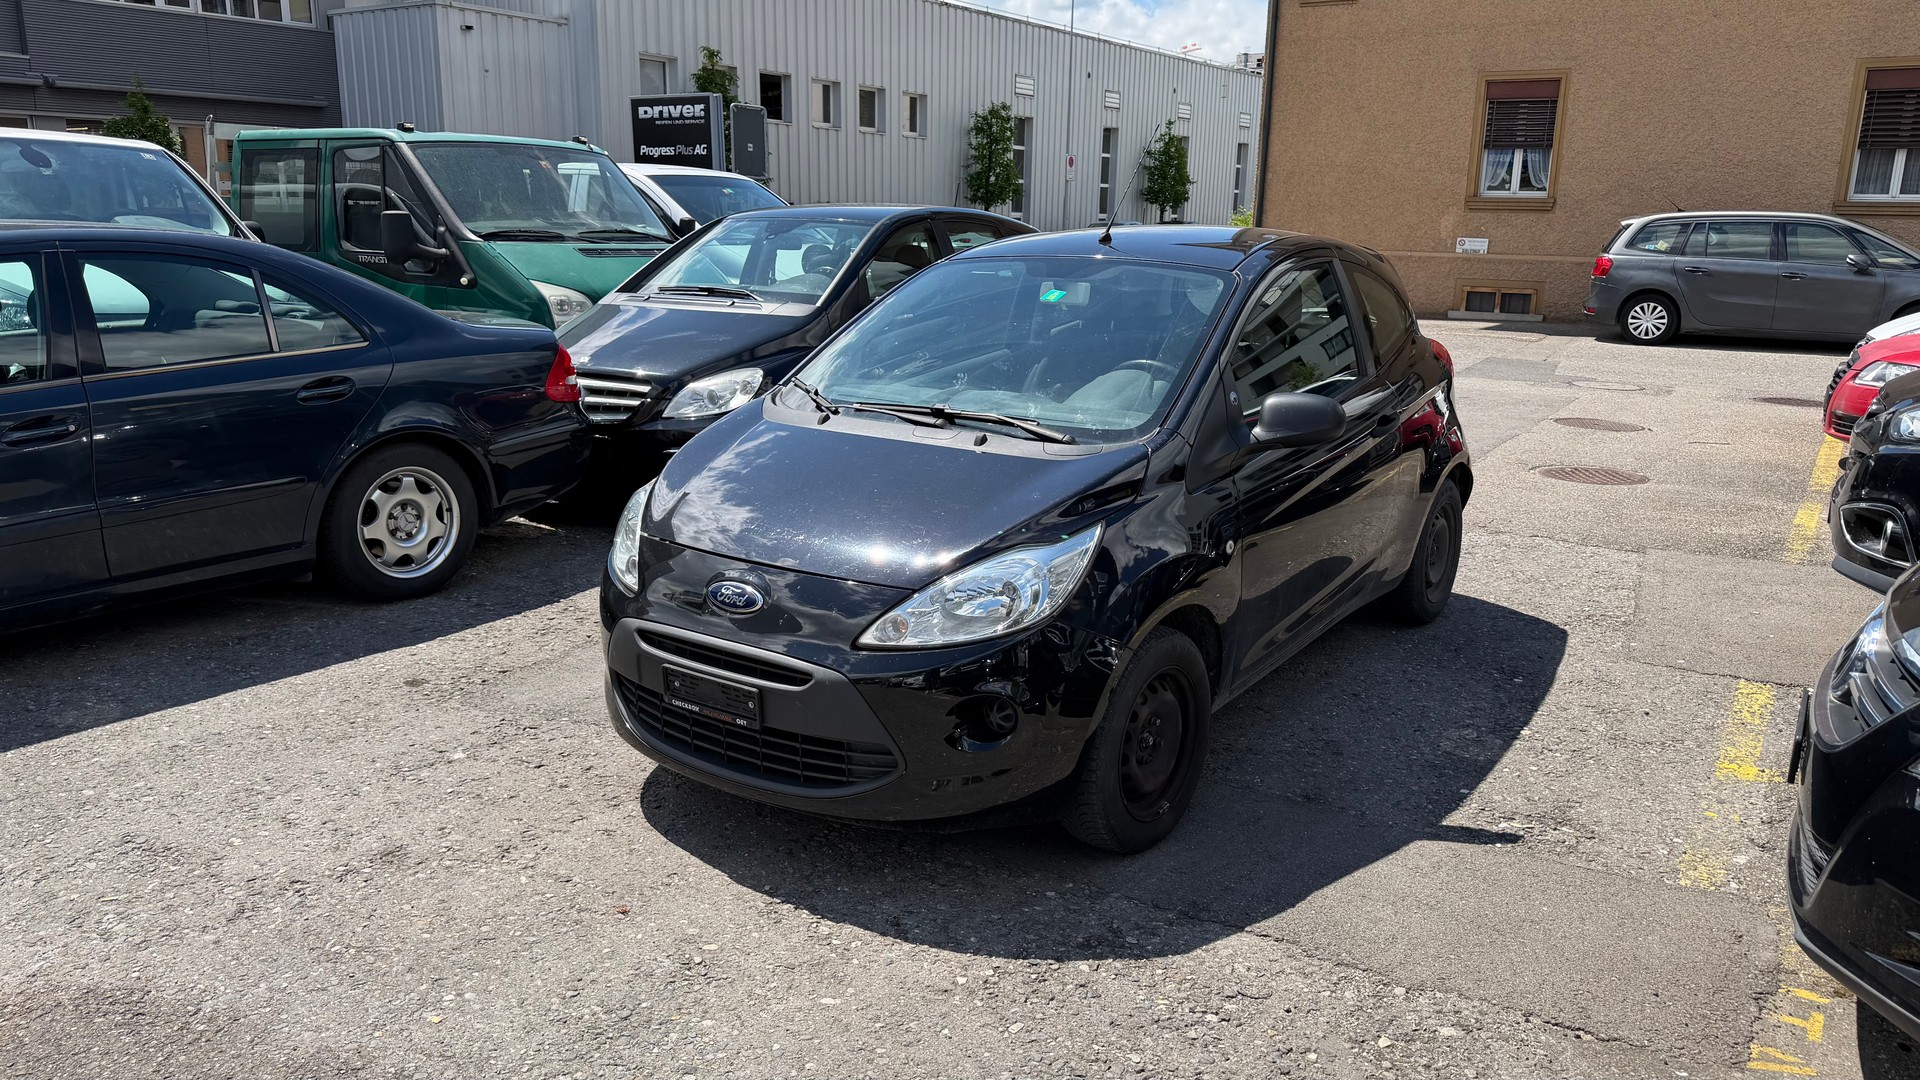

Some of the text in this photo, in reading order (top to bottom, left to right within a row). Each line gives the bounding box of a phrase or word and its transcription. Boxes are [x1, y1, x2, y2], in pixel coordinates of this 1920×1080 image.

[640, 144, 707, 157] Progress Plus AG
[717, 585, 749, 606] Ford
[672, 699, 700, 712] CHECKBOX
